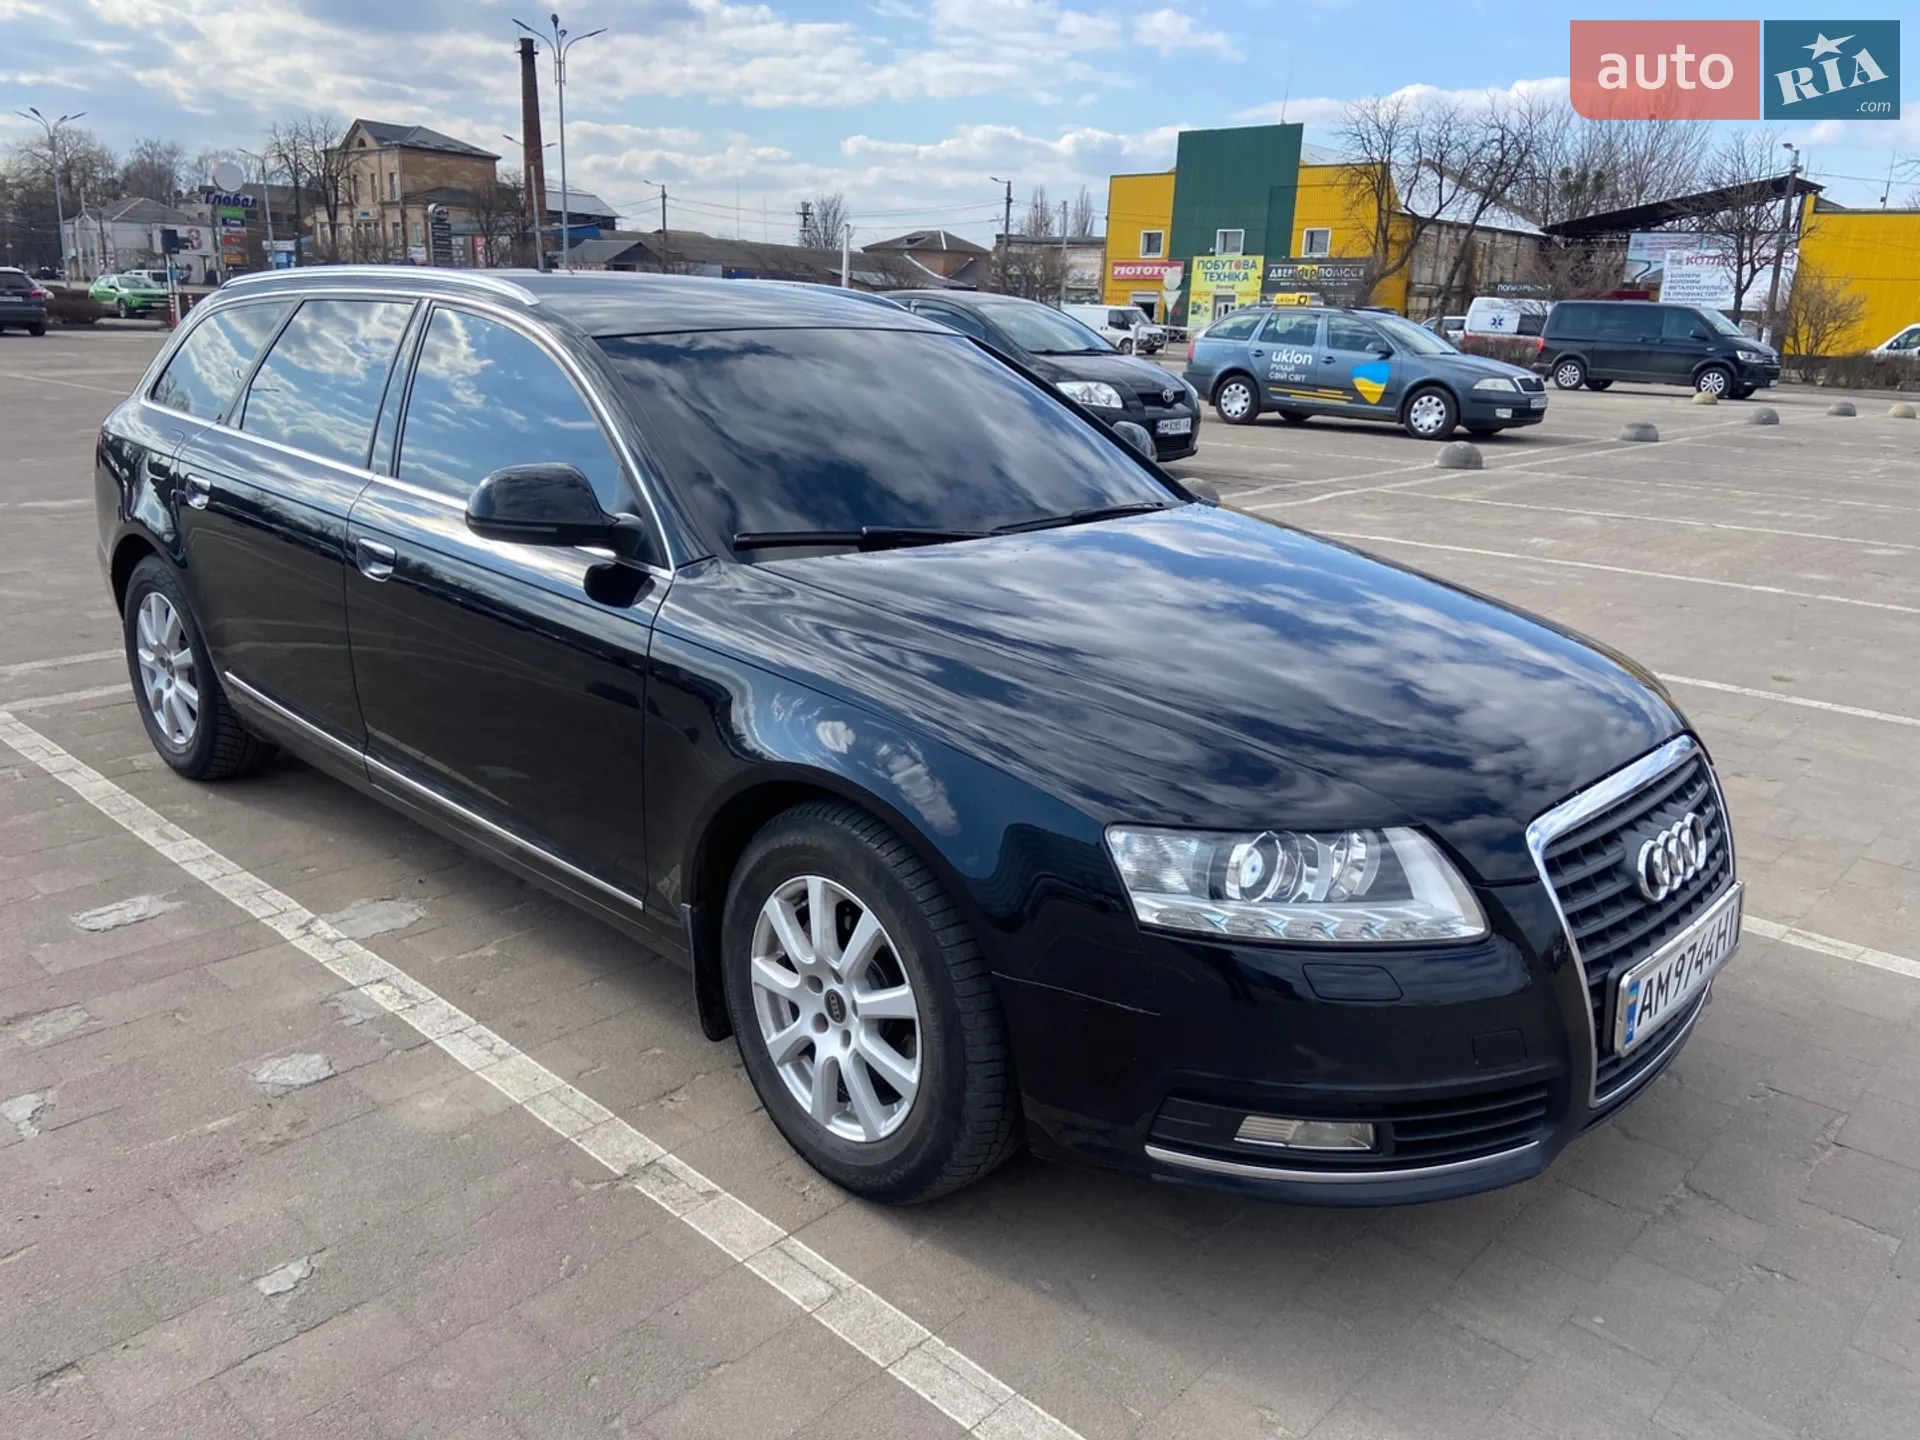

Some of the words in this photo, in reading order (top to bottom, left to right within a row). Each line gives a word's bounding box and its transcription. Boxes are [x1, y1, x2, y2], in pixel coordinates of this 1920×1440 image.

[203, 190, 258, 209] Глобал
[1197, 259, 1258, 271] ПОБУТОВА
[1203, 271, 1250, 282] ТЕХНІКА
[1272, 349, 1313, 366] uklon
